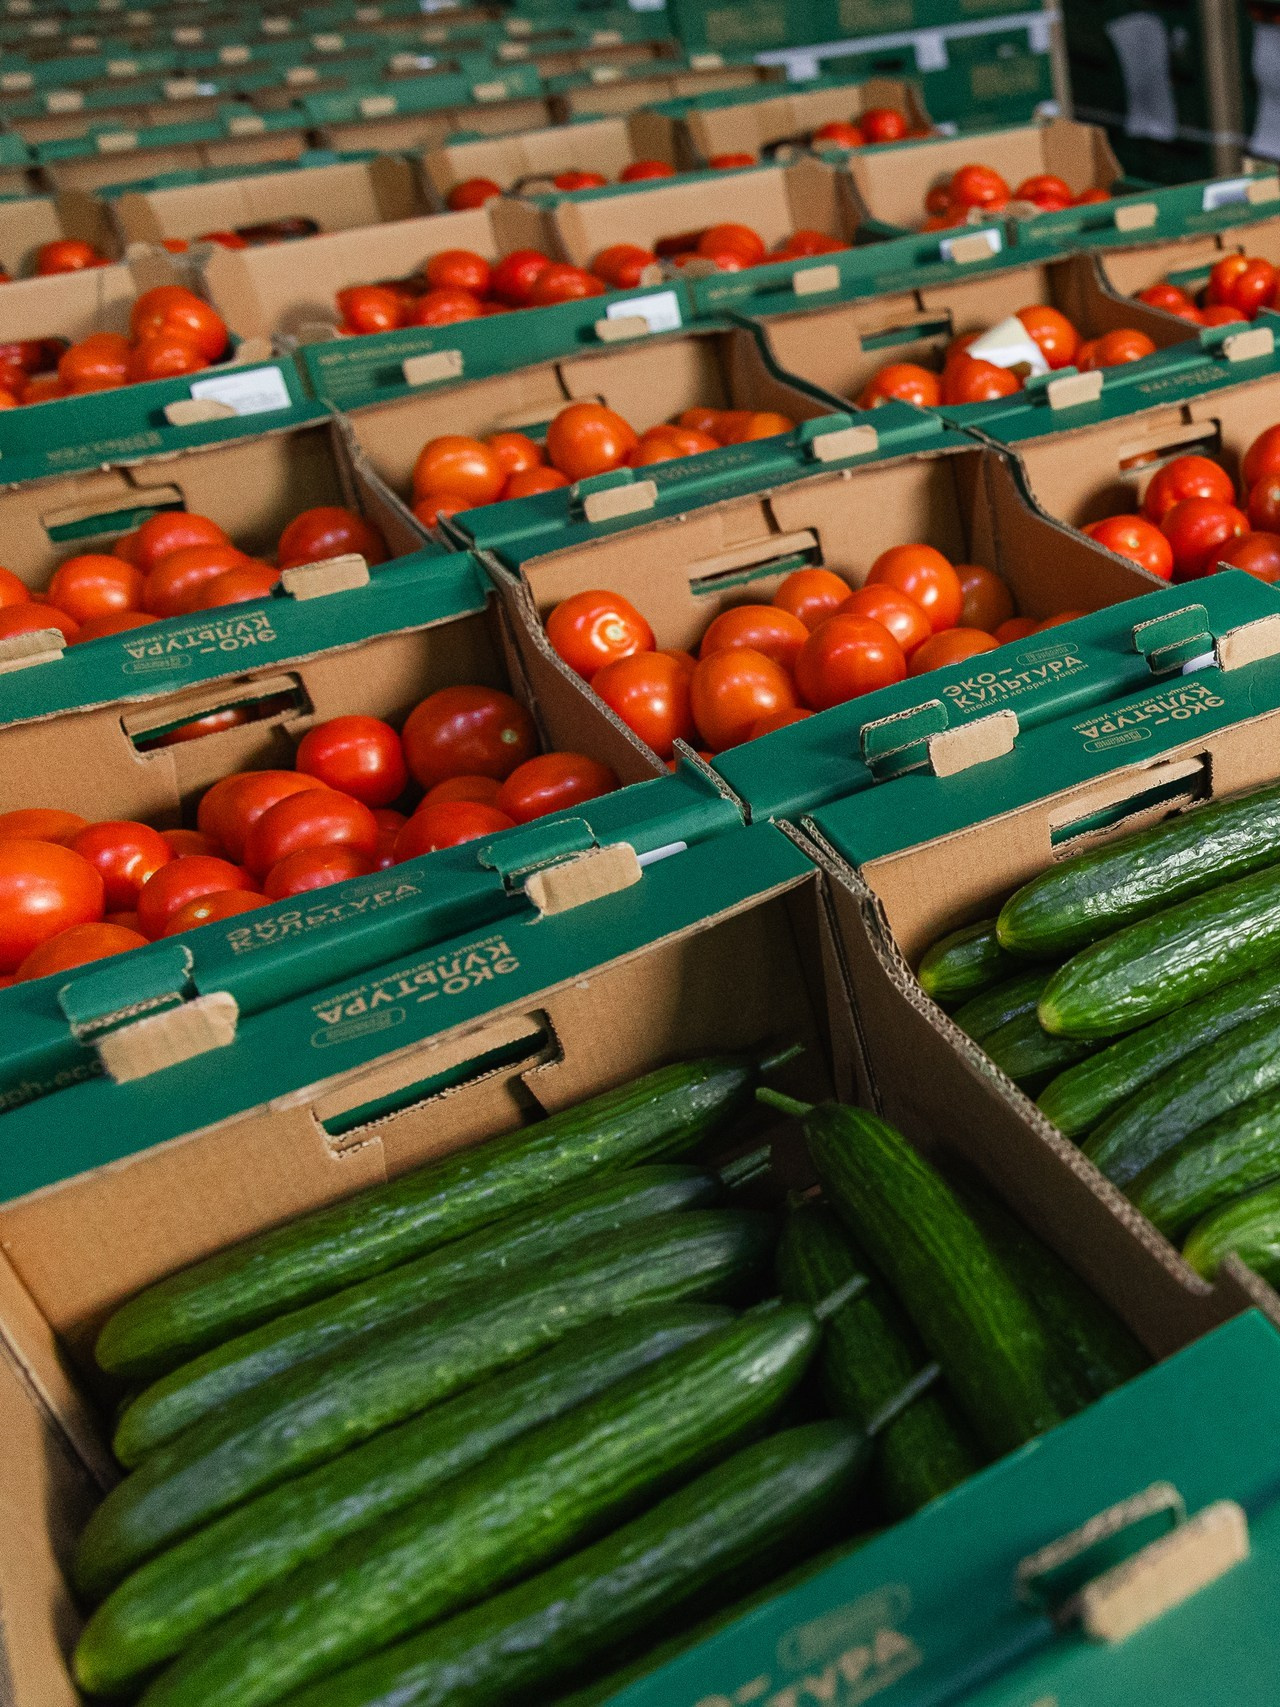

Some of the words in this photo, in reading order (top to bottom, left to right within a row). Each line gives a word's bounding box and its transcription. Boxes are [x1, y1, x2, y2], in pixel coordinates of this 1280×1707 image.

[127, 616, 270, 659] КУЛЬТУРА
[201, 629, 277, 654] ЭКО-
[942, 668, 1013, 697] ЭКО-
[952, 656, 1083, 709] КУЛЬТУРА
[1010, 679, 1053, 695] которых
[1055, 664, 1089, 681] уверен
[1072, 713, 1111, 731] уверен
[1078, 686, 1213, 739] КУЛЬТУРА
[1112, 698, 1155, 716] которых
[1155, 696, 1225, 725] ЭКО-
[230, 885, 418, 953] КУЛЬТУРА
[316, 941, 511, 1024] КУЛЬТУРА
[416, 956, 520, 1003] ЭКО-
